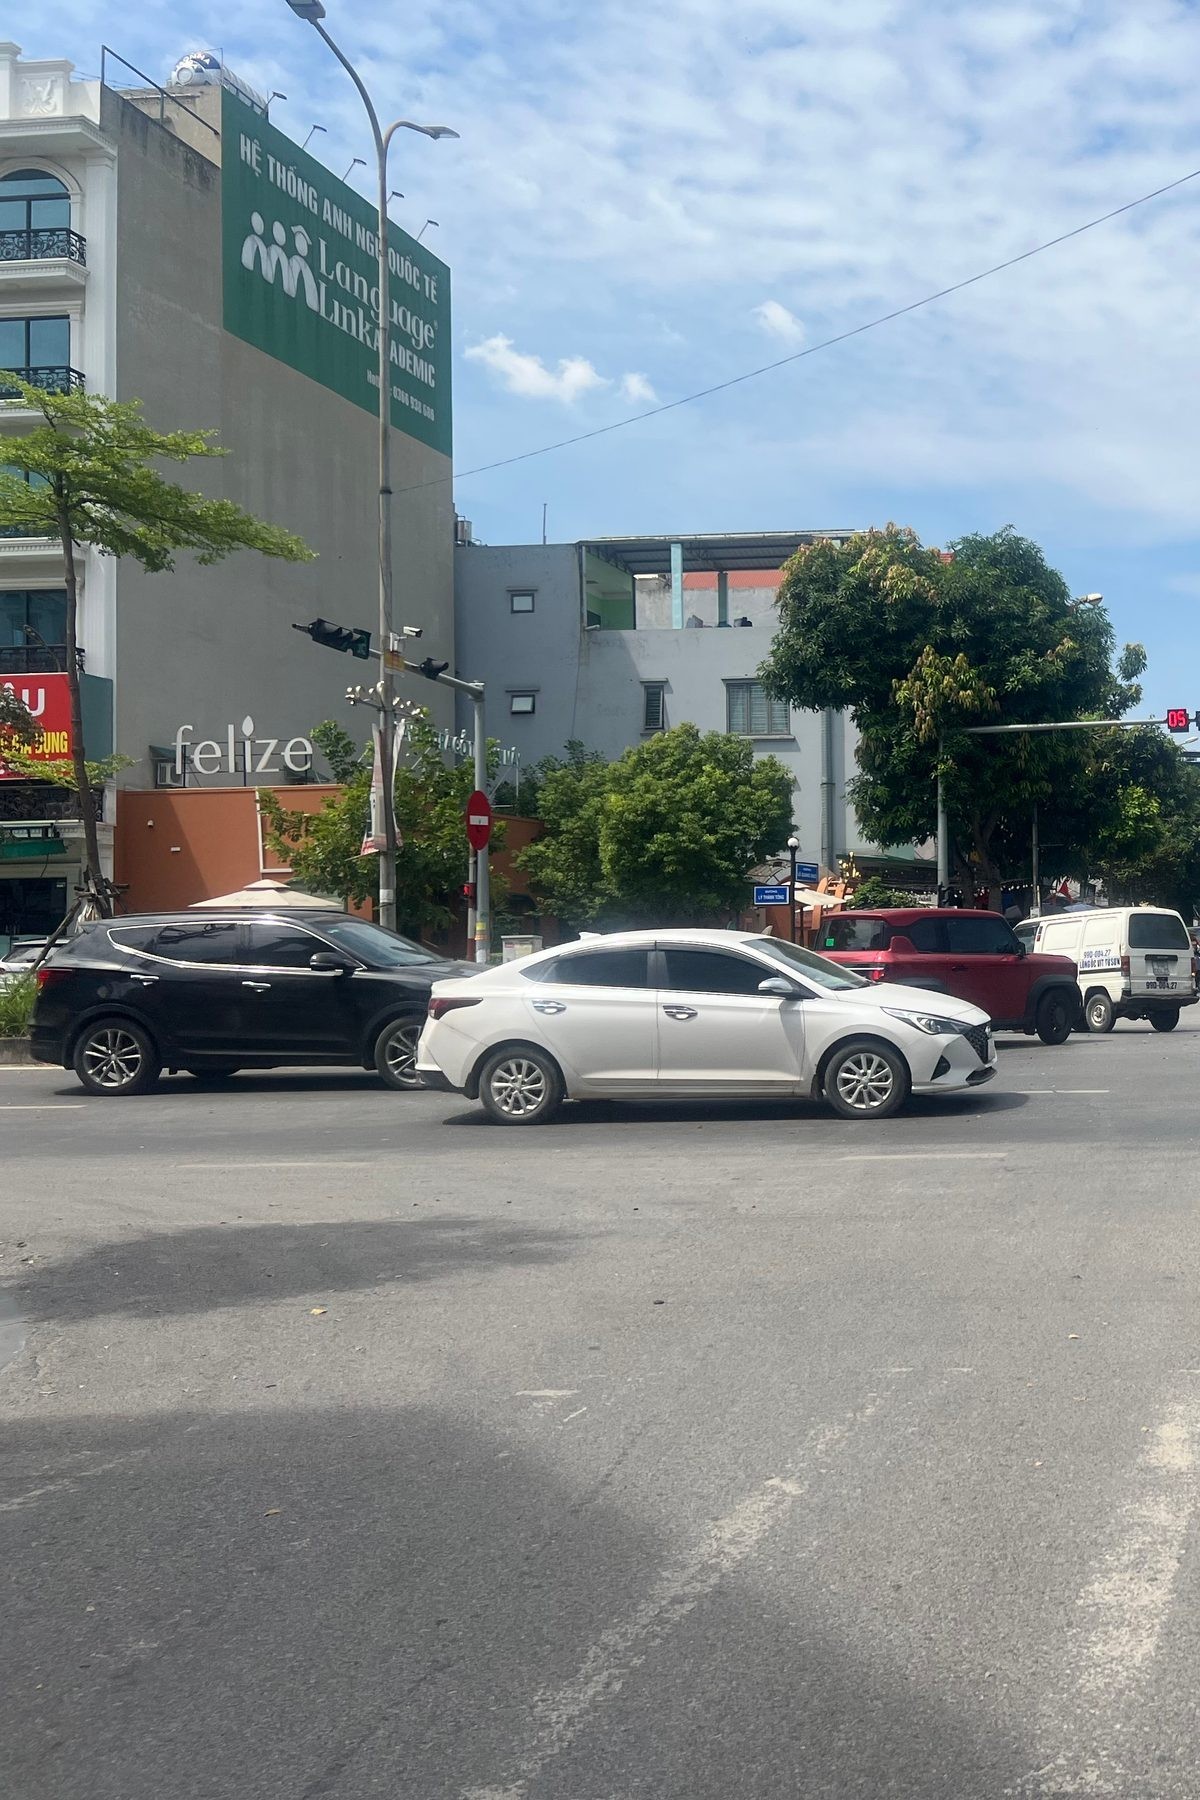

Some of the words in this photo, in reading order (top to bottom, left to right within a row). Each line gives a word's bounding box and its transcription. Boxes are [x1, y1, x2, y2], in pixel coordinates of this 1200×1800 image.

[240, 133, 262, 177] HỆ
[267, 154, 318, 215] THỐNG
[322, 198, 352, 241] ANH
[387, 247, 420, 291] QUỐC
[423, 273, 438, 305] TẾ
[374, 328, 435, 388] AADEMIC
[171, 715, 313, 775] felize
[1168, 711, 1186, 728] 05
